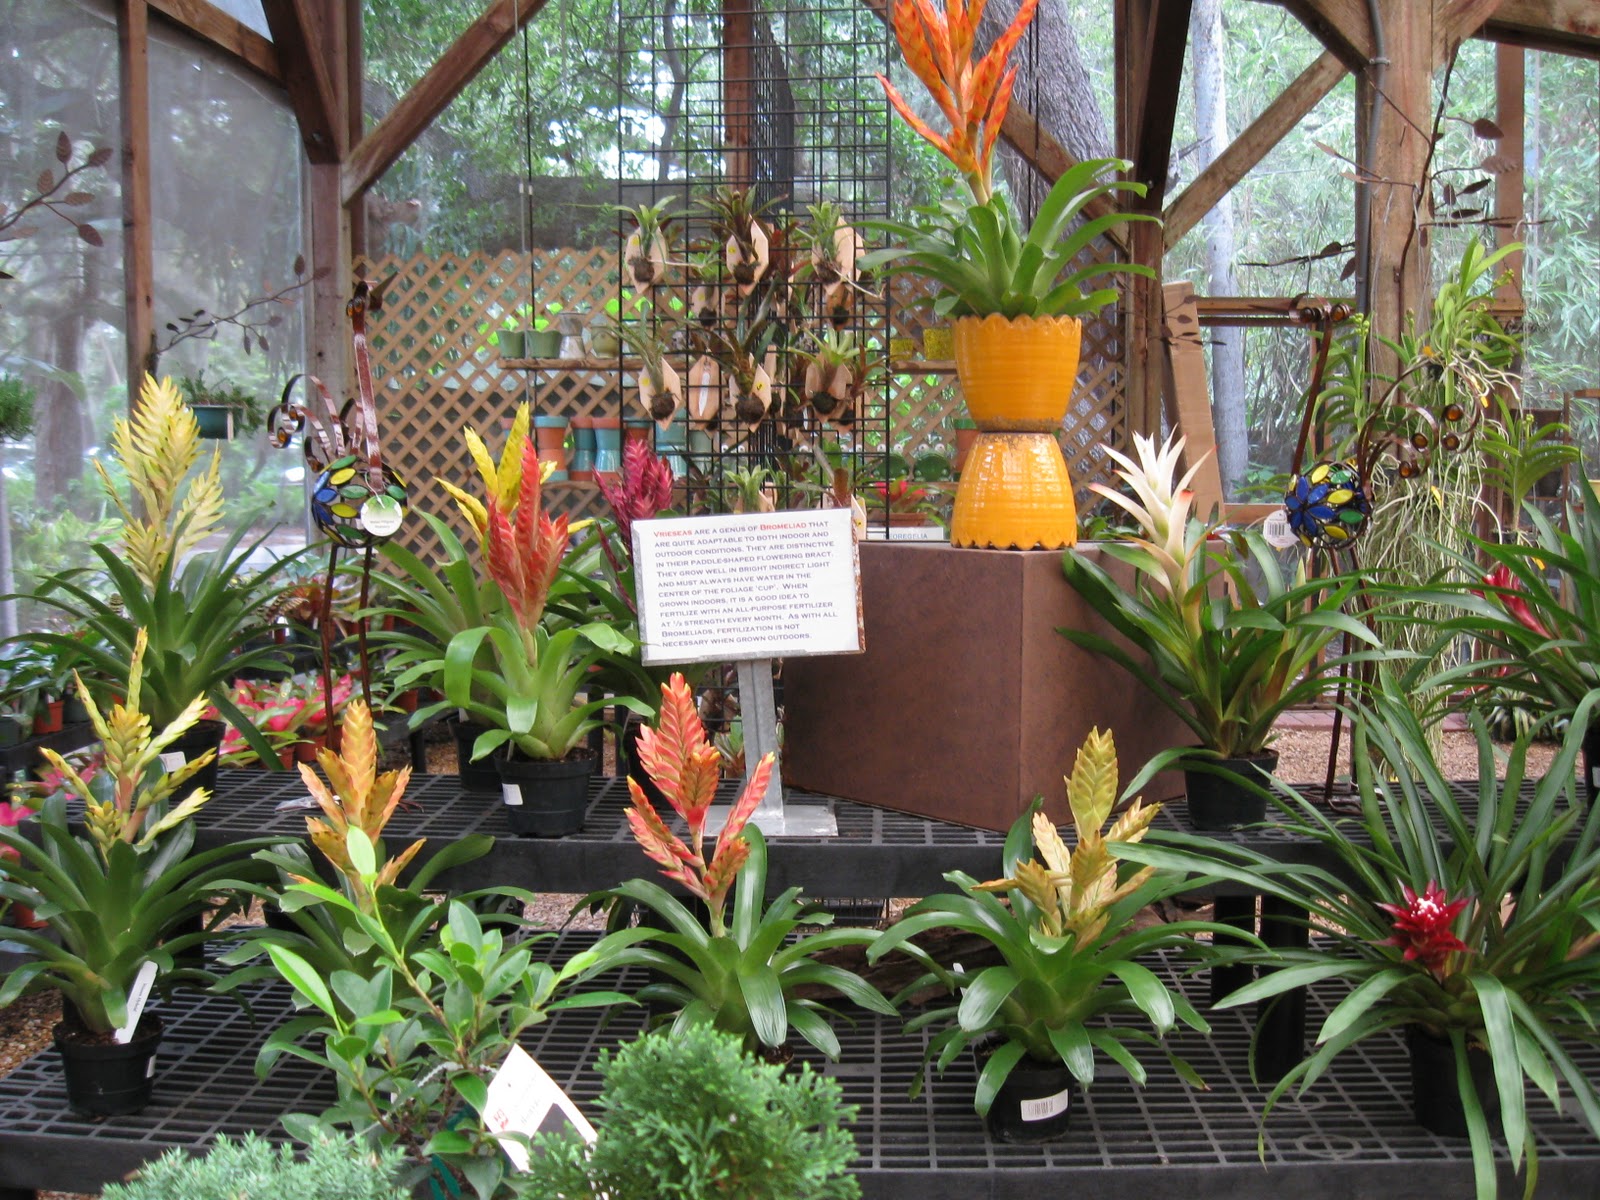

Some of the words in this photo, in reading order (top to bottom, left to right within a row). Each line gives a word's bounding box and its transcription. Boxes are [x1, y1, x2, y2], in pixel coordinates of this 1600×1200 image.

[655, 549, 692, 558] OUTDOOR
[695, 547, 743, 555] CONDITIONS.
[787, 541, 834, 549] DISTINCTIVE
[691, 557, 755, 566] PADDLE-SHAPED
[757, 552, 803, 561] FLOWERING
[717, 625, 773, 634] FERTILIZATION
